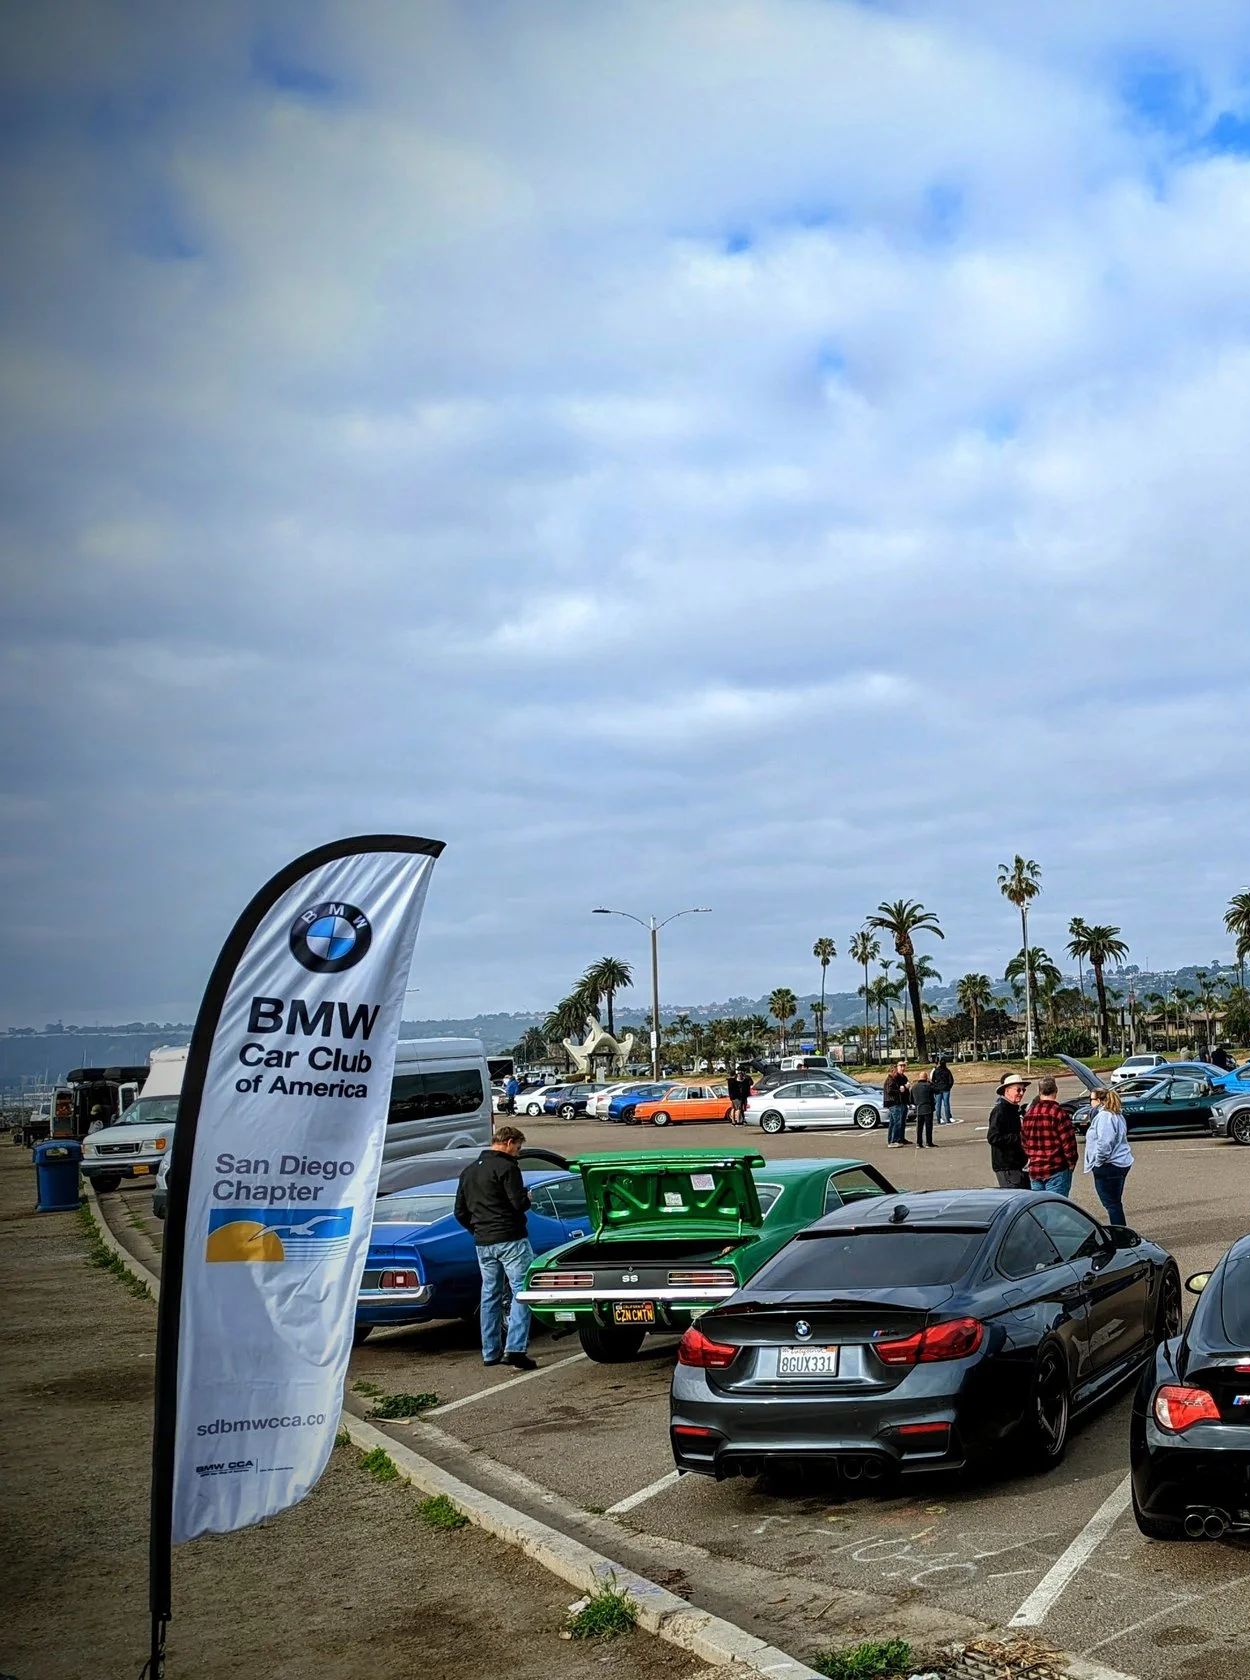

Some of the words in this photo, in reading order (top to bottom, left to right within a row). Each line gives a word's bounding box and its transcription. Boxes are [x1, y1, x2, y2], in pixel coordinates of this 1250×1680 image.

[301, 903, 367, 930] BMW
[247, 996, 381, 1040] BMW
[239, 1042, 299, 1068] Car
[308, 1046, 372, 1073] Club
[235, 1075, 263, 1093] of
[268, 1075, 368, 1098] America
[215, 1153, 270, 1174] San
[279, 1155, 355, 1180] Diego
[212, 1180, 324, 1205] Chapter
[615, 1310, 631, 1322] CZN
[632, 1309, 653, 1322] CMTN
[781, 1356, 832, 1372] 8GUX331
[197, 1413, 326, 1436] sdbmwcca.co
[196, 1463, 225, 1473] BMW
[228, 1460, 254, 1469] CCA
